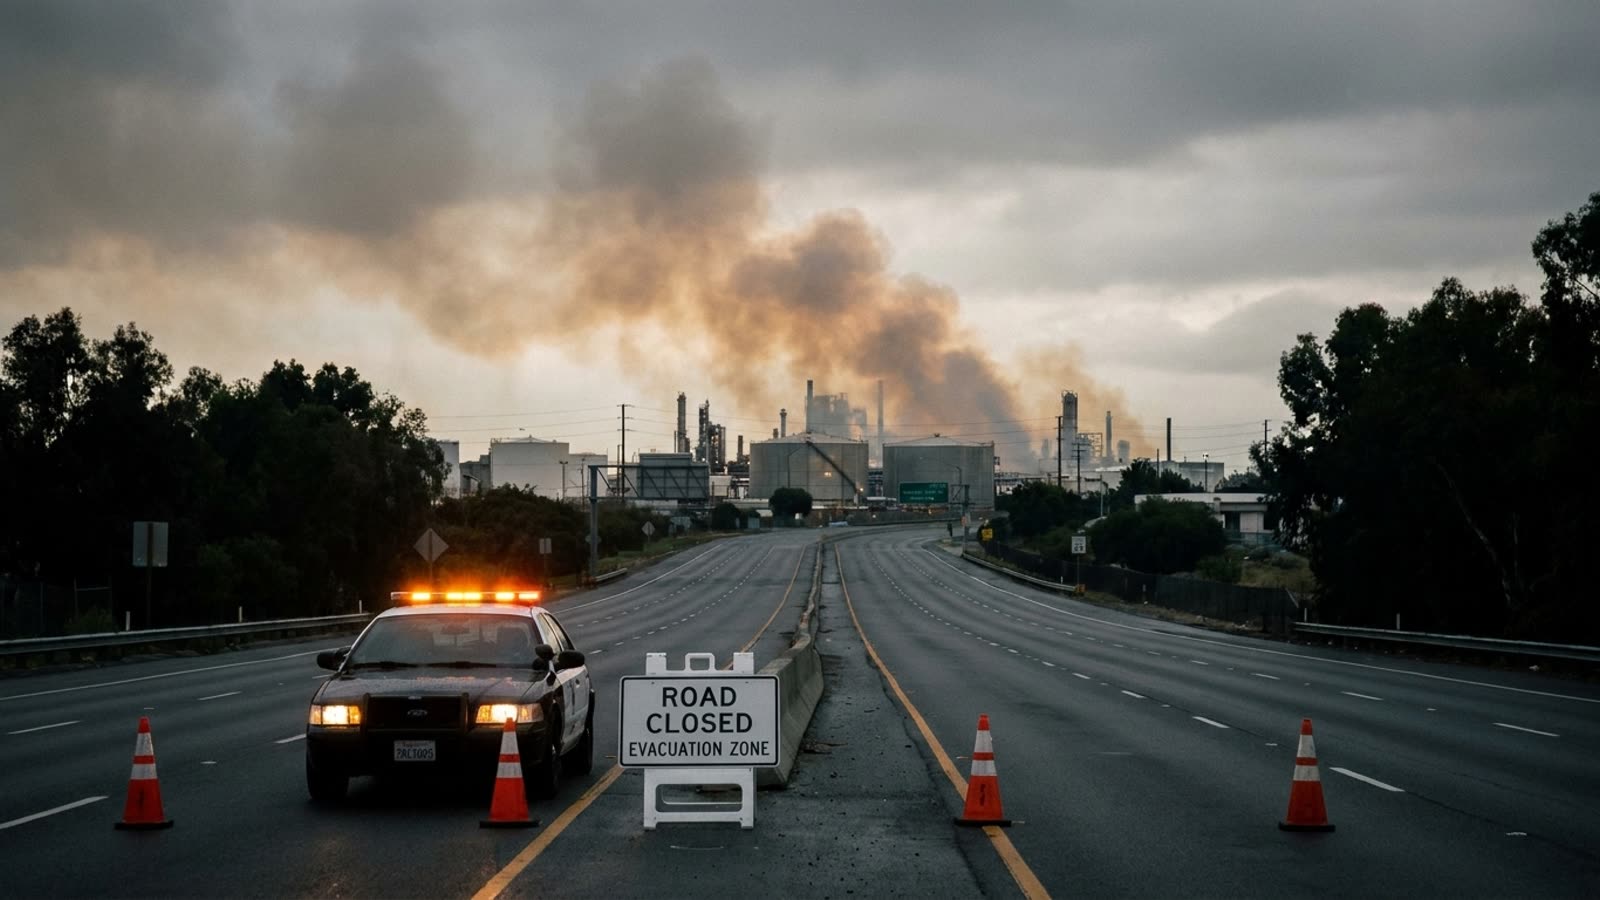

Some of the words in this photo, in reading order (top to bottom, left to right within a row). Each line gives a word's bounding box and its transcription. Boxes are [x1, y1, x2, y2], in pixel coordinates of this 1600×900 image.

[662, 686, 737, 708] ROAD
[646, 712, 753, 734] CLOSED
[629, 741, 723, 757] EVACUATION
[729, 741, 770, 757] ZONE
